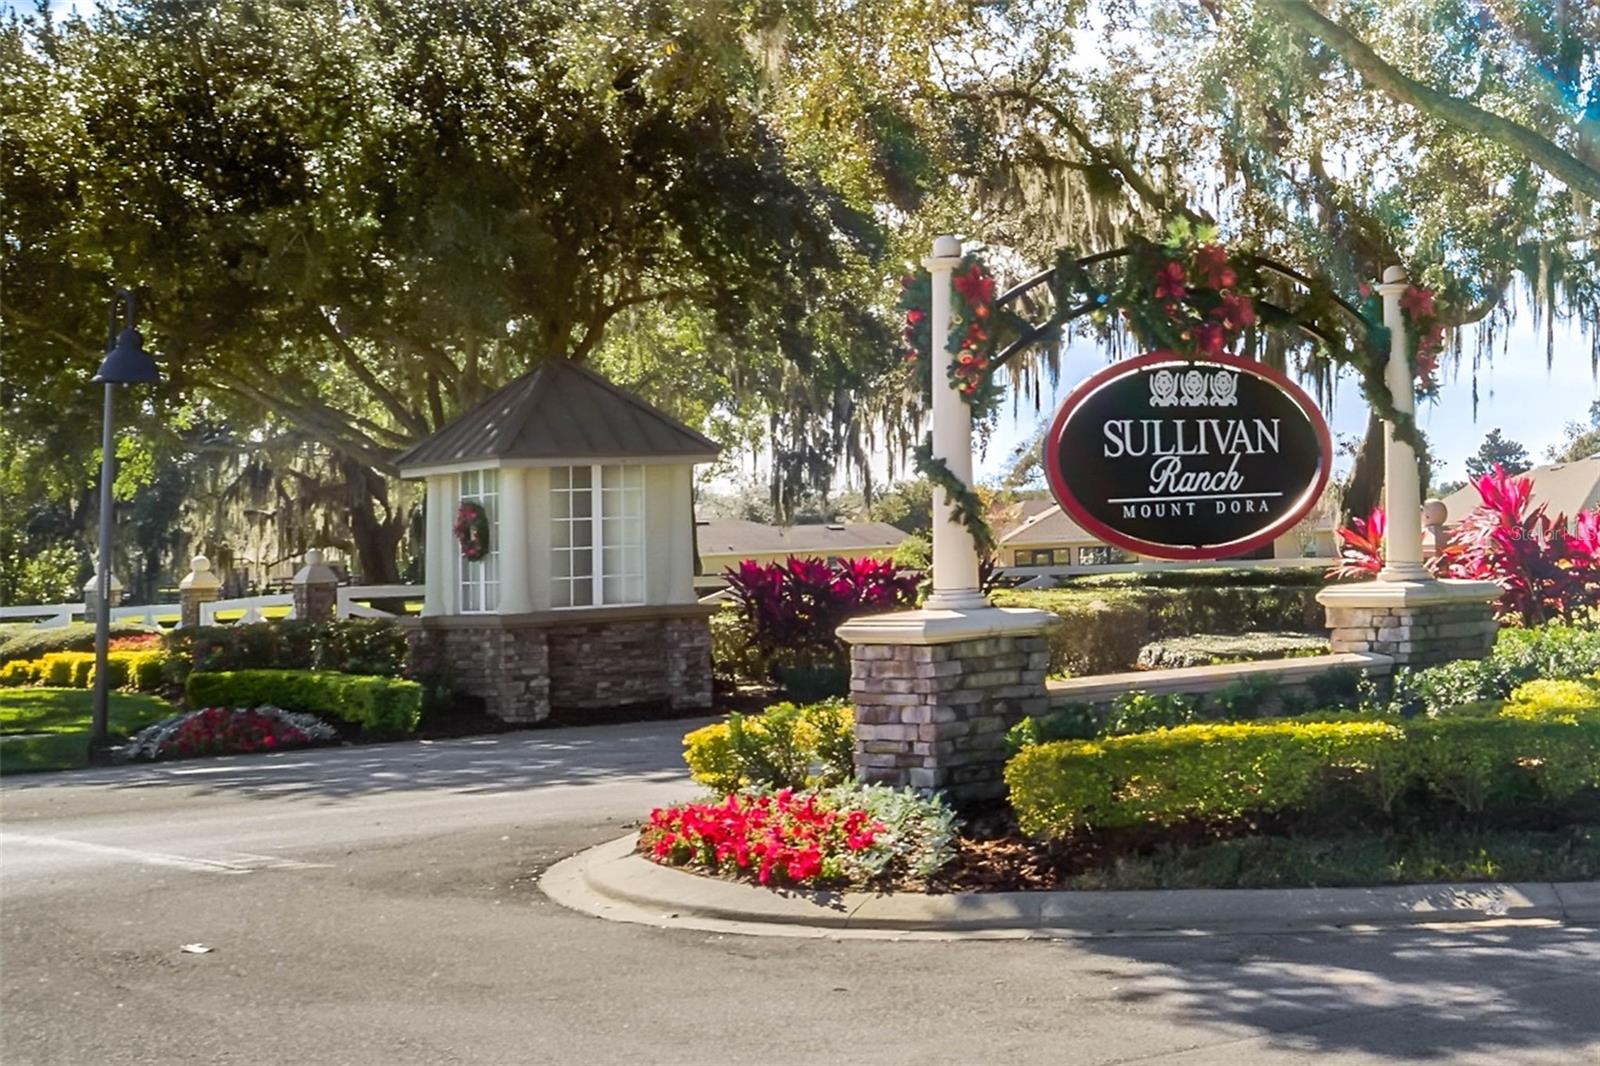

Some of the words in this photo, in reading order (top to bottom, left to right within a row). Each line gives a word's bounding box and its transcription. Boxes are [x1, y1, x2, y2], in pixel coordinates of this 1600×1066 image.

[1103, 419, 1280, 457] SULLIVAN
[1149, 453, 1244, 494] Ranch
[1123, 502, 1196, 519] MOUNT
[1216, 500, 1270, 515] DORA
